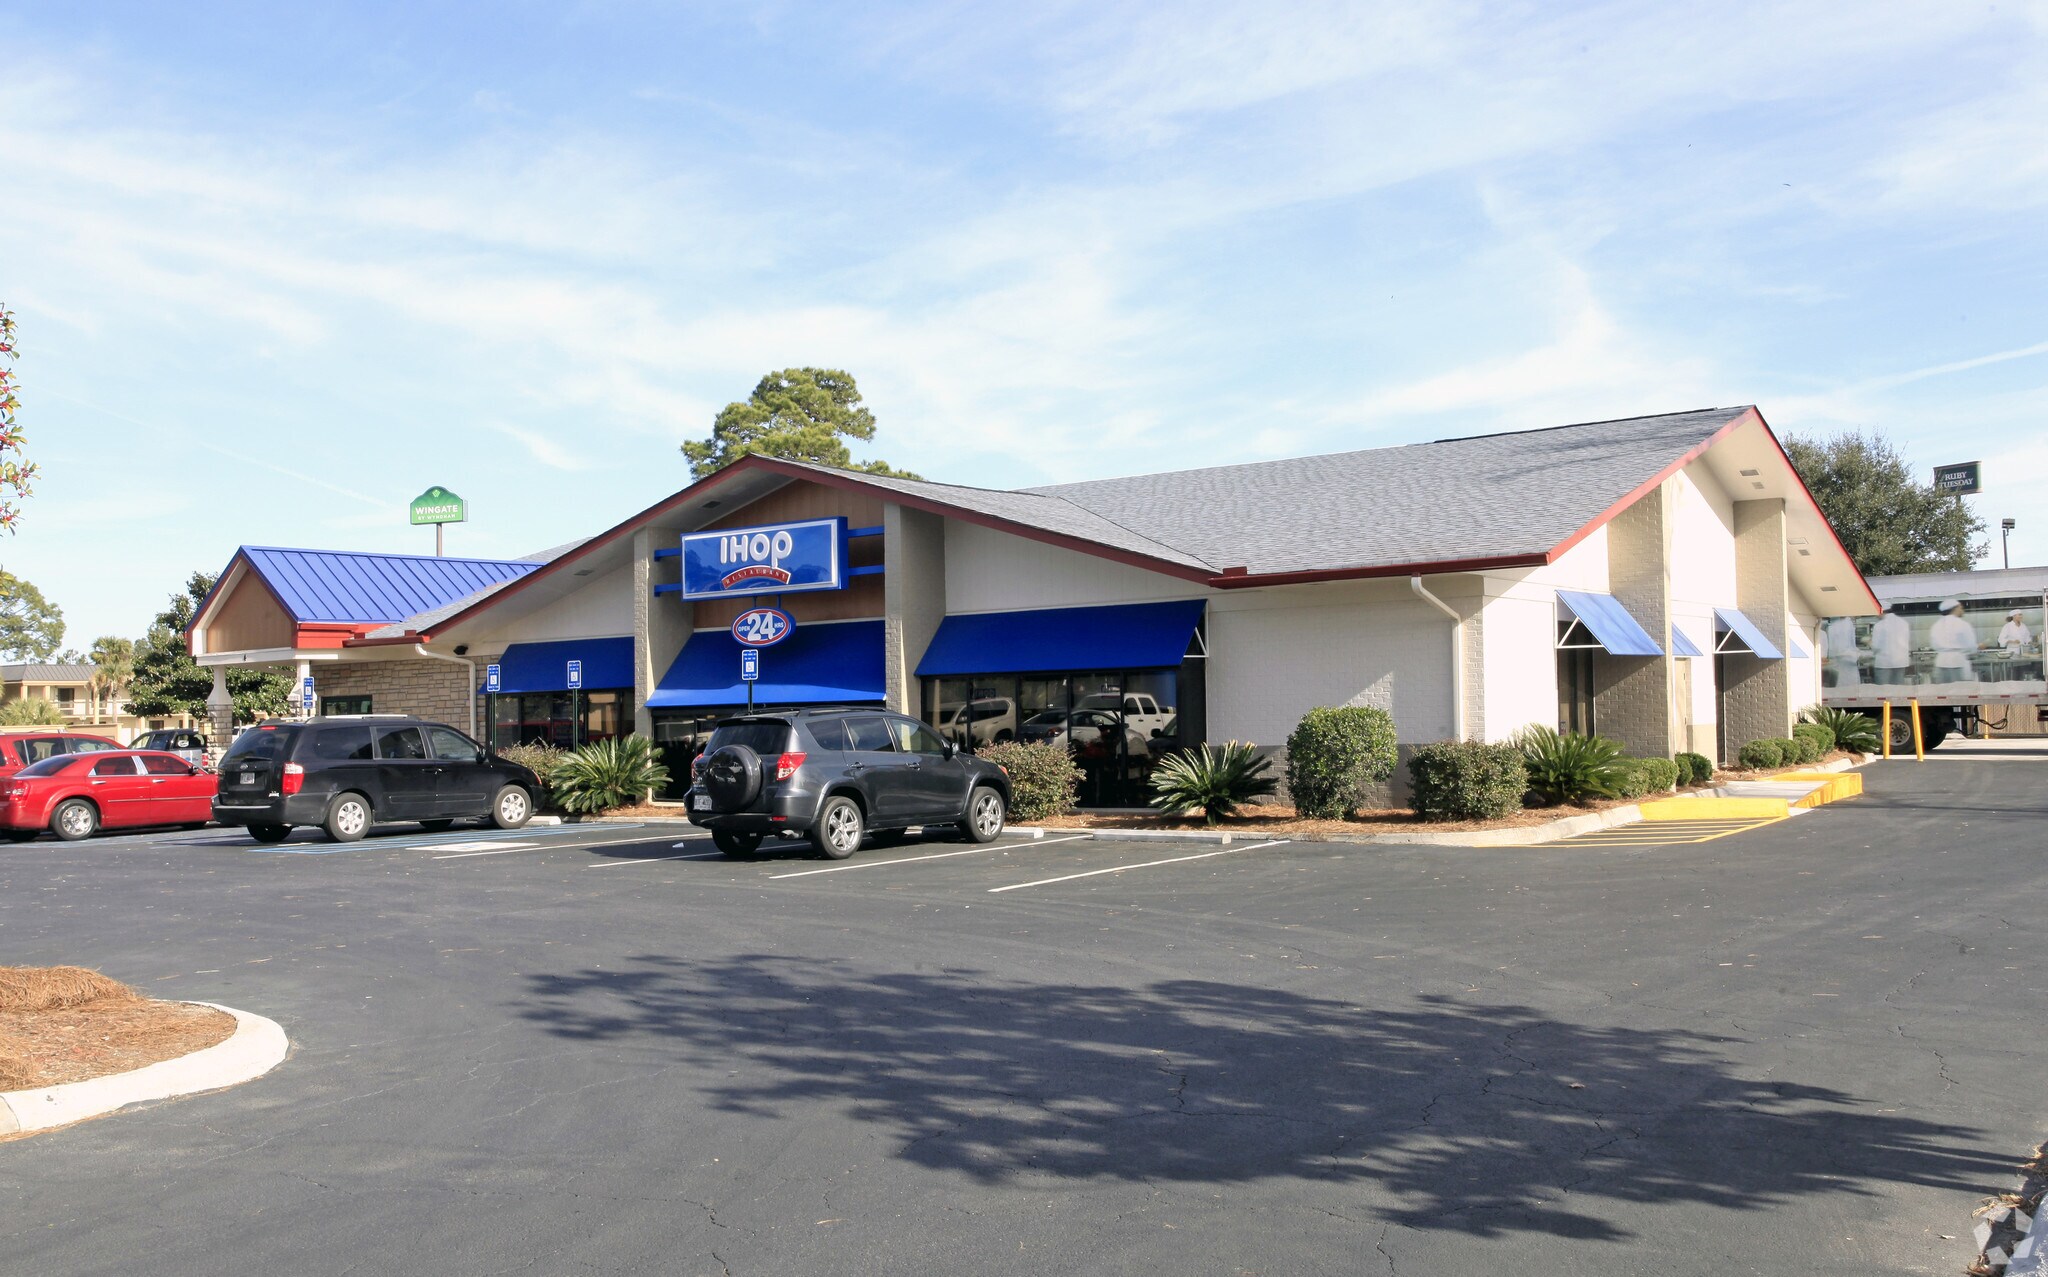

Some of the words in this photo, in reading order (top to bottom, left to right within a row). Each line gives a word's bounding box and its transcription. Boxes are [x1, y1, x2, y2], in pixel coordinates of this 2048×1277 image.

[1945, 472, 1967, 480] RUBY
[1939, 478, 1974, 488] TUESDAY
[415, 504, 458, 515] WINGATE
[725, 568, 785, 584] RESTAURANT
[747, 611, 776, 641] 24
